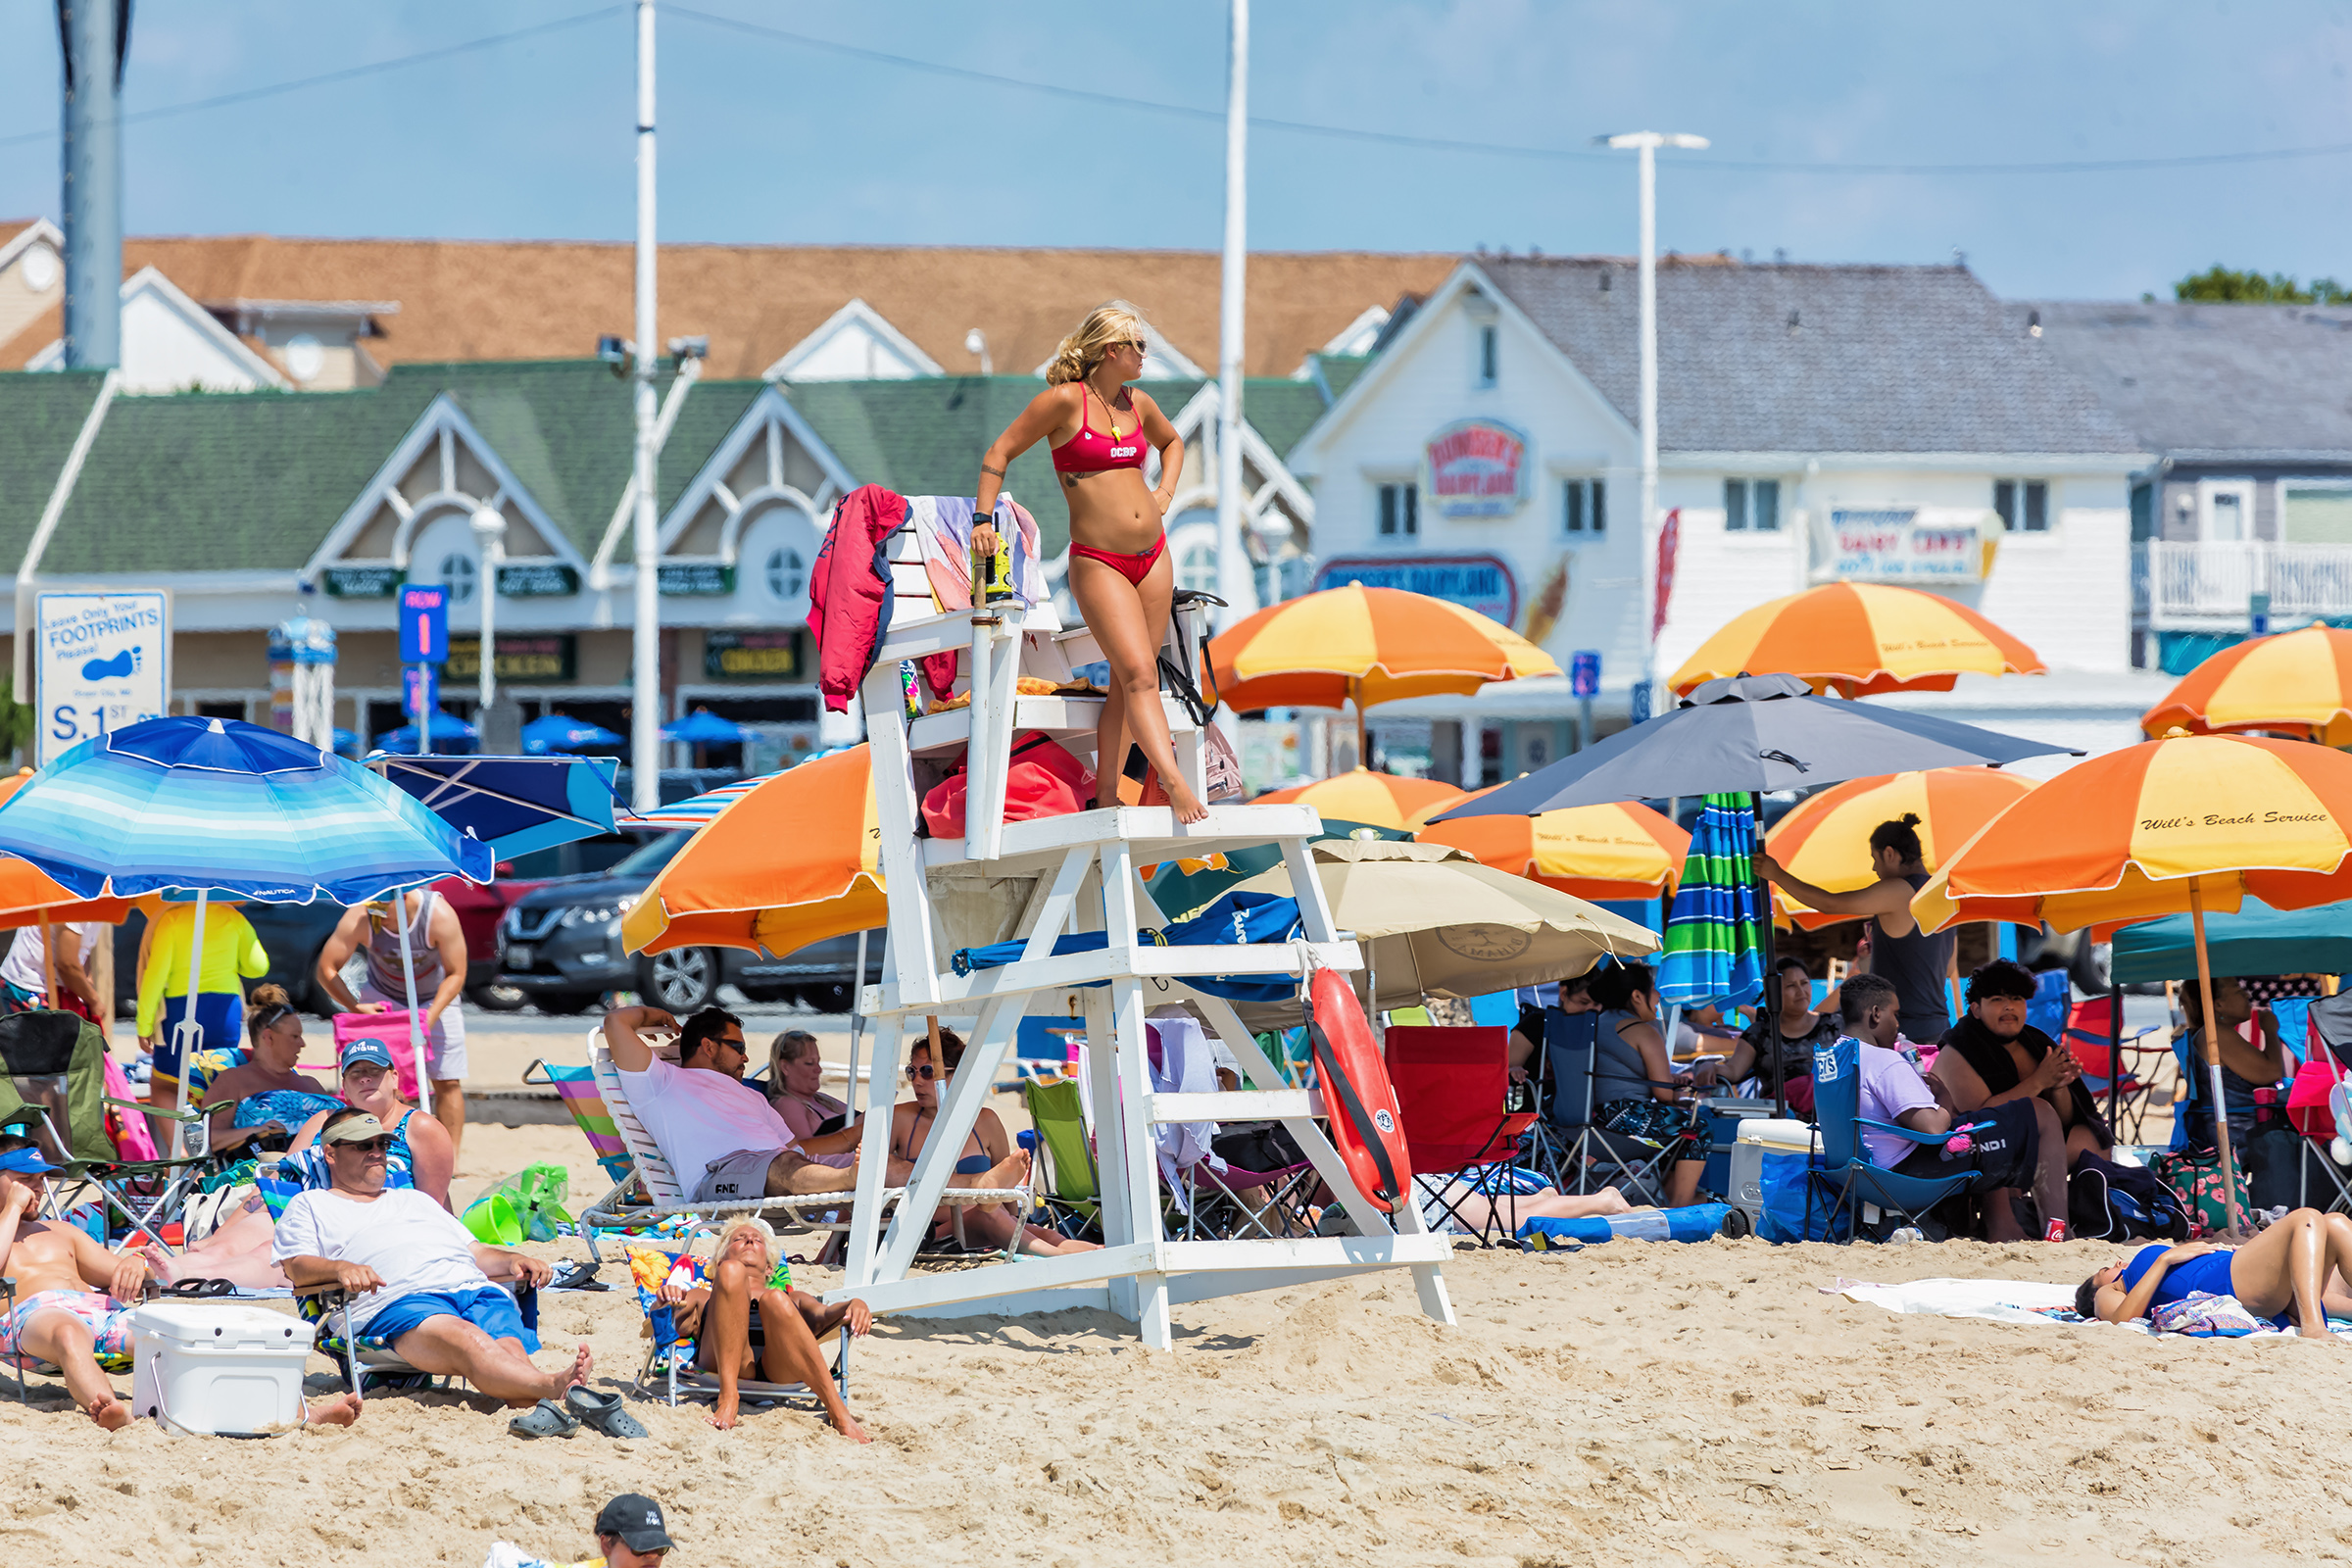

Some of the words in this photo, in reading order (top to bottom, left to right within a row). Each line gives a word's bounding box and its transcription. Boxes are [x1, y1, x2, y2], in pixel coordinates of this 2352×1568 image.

[1109, 446, 1137, 458] OCBP
[42, 613, 78, 630] Leave
[81, 607, 110, 621] Only
[113, 600, 138, 612] Your
[49, 608, 160, 647] FOOTPRINTS
[2140, 815, 2195, 830] Will's
[2203, 812, 2255, 826] Beach
[2263, 810, 2328, 824] Service
